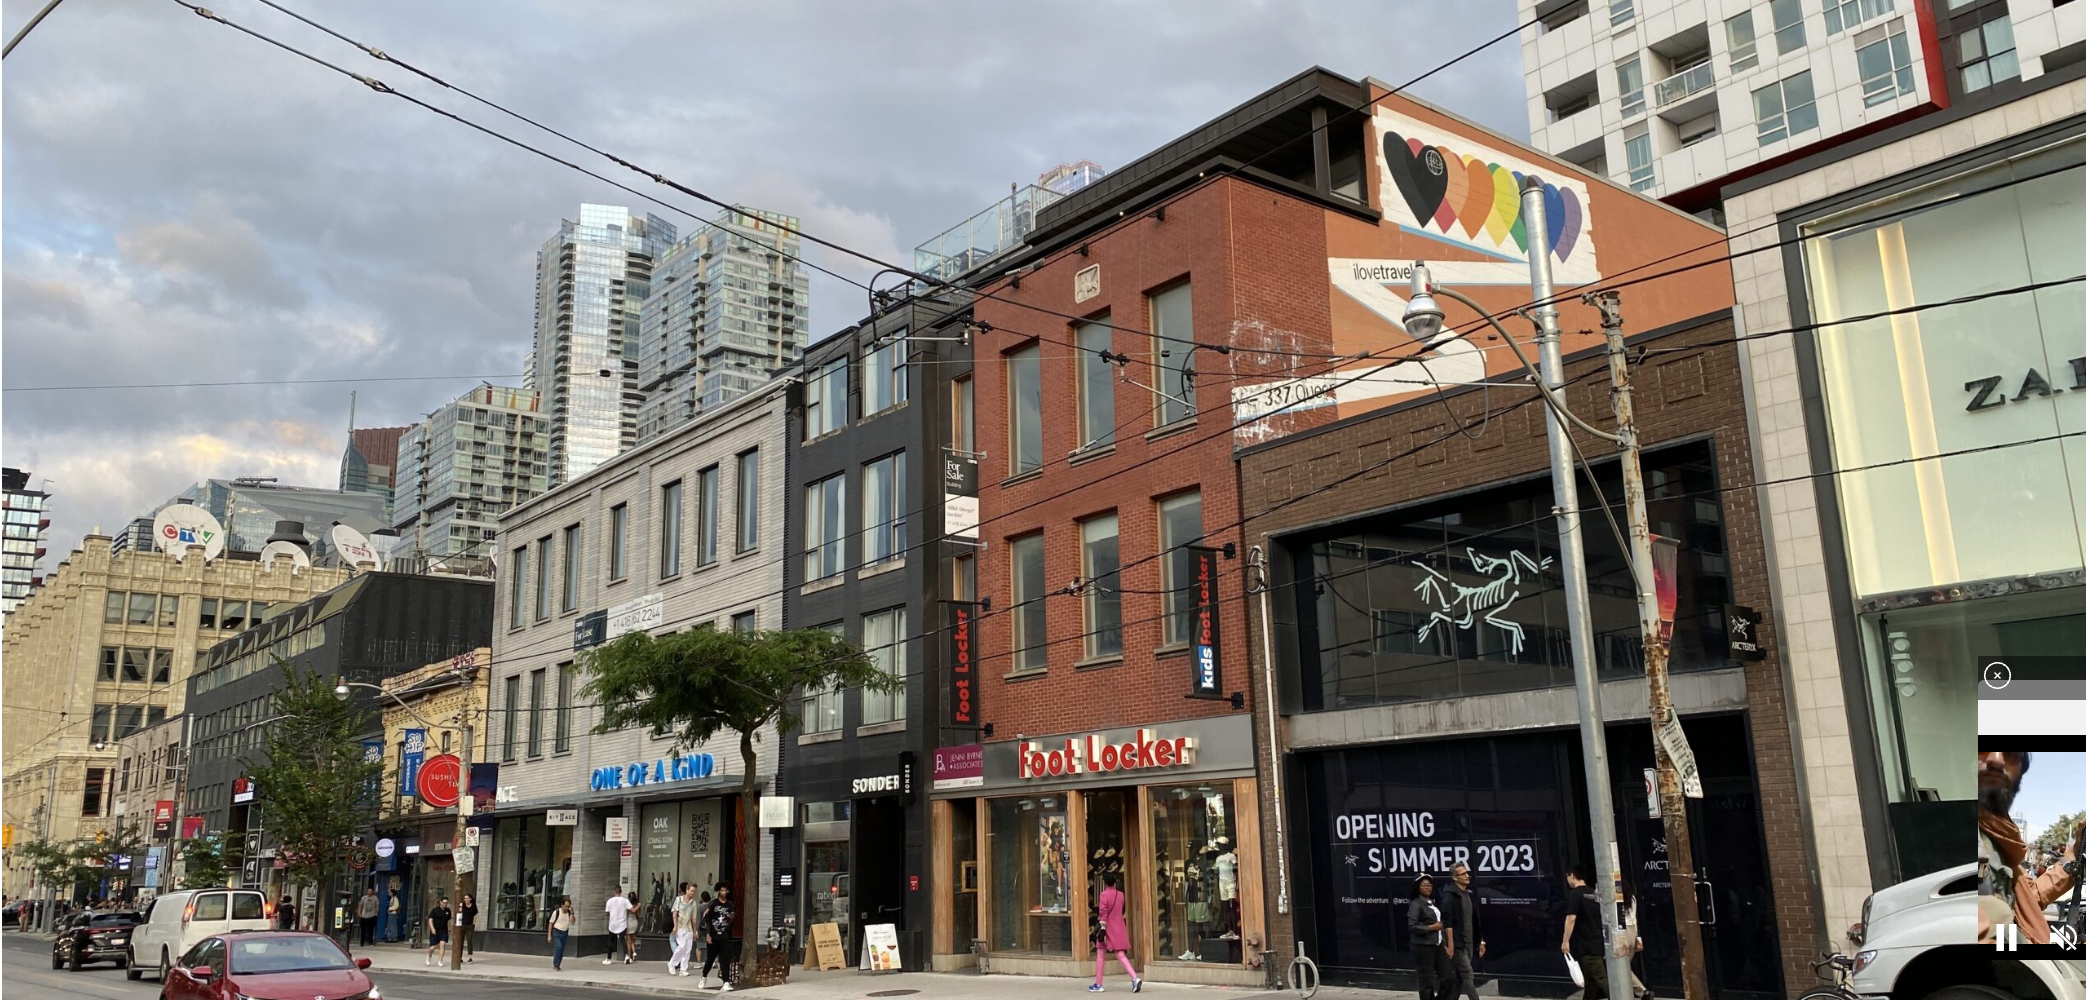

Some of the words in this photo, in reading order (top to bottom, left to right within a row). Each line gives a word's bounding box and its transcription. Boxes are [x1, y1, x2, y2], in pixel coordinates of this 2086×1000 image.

[1265, 386, 1291, 407] 337
[946, 469, 964, 481] Sale
[947, 460, 961, 471] For
[162, 523, 215, 545] CTV
[342, 543, 372, 559] TSN
[1198, 554, 1210, 607] Locker
[1199, 611, 1212, 646] Foot
[954, 608, 969, 673] Locker
[1200, 647, 1214, 689] kids
[955, 679, 970, 722] Foot
[404, 740, 424, 754] HIP
[407, 732, 422, 744] SO
[950, 753, 966, 763] JENNI
[966, 750, 983, 760] BYRNE
[1019, 737, 1082, 779] Foot
[1085, 728, 1192, 774] Locker
[430, 773, 452, 781] SUSHI
[591, 765, 624, 791] ONE
[627, 761, 650, 787] OF
[653, 758, 666, 783] A
[852, 774, 900, 794] SONDER
[495, 785, 517, 803] ACE
[653, 817, 668, 829] OAK
[765, 811, 786, 820] ration
[1336, 811, 1435, 840] OPENING
[1368, 846, 1472, 873] SUMMER
[1476, 844, 1535, 872] 2023
[817, 891, 836, 900] ration
[1341, 896, 1357, 904] Follow
